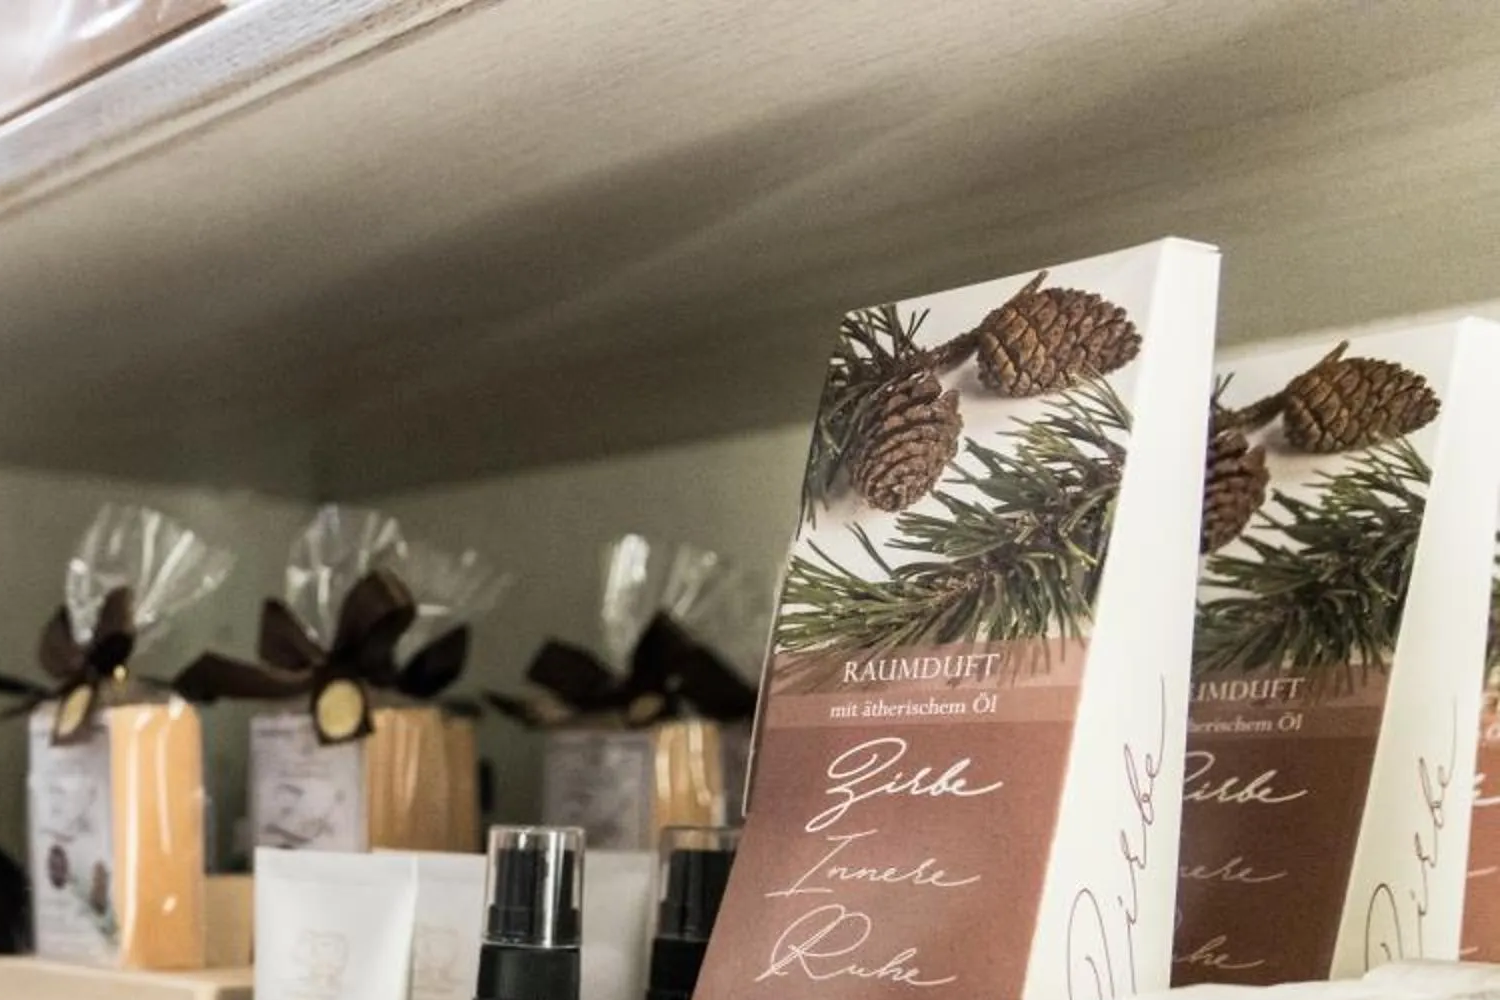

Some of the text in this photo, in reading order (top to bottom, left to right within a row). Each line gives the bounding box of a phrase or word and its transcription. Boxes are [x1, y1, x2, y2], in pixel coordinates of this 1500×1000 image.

[843, 653, 1000, 683] RAUMDUFT
[1190, 677, 1305, 701] MDUFT
[830, 692, 998, 718] mit ätherischem Öl
[805, 737, 1003, 832] Zirbe
[764, 829, 981, 898] Innere
[754, 903, 958, 986] Ruhe
